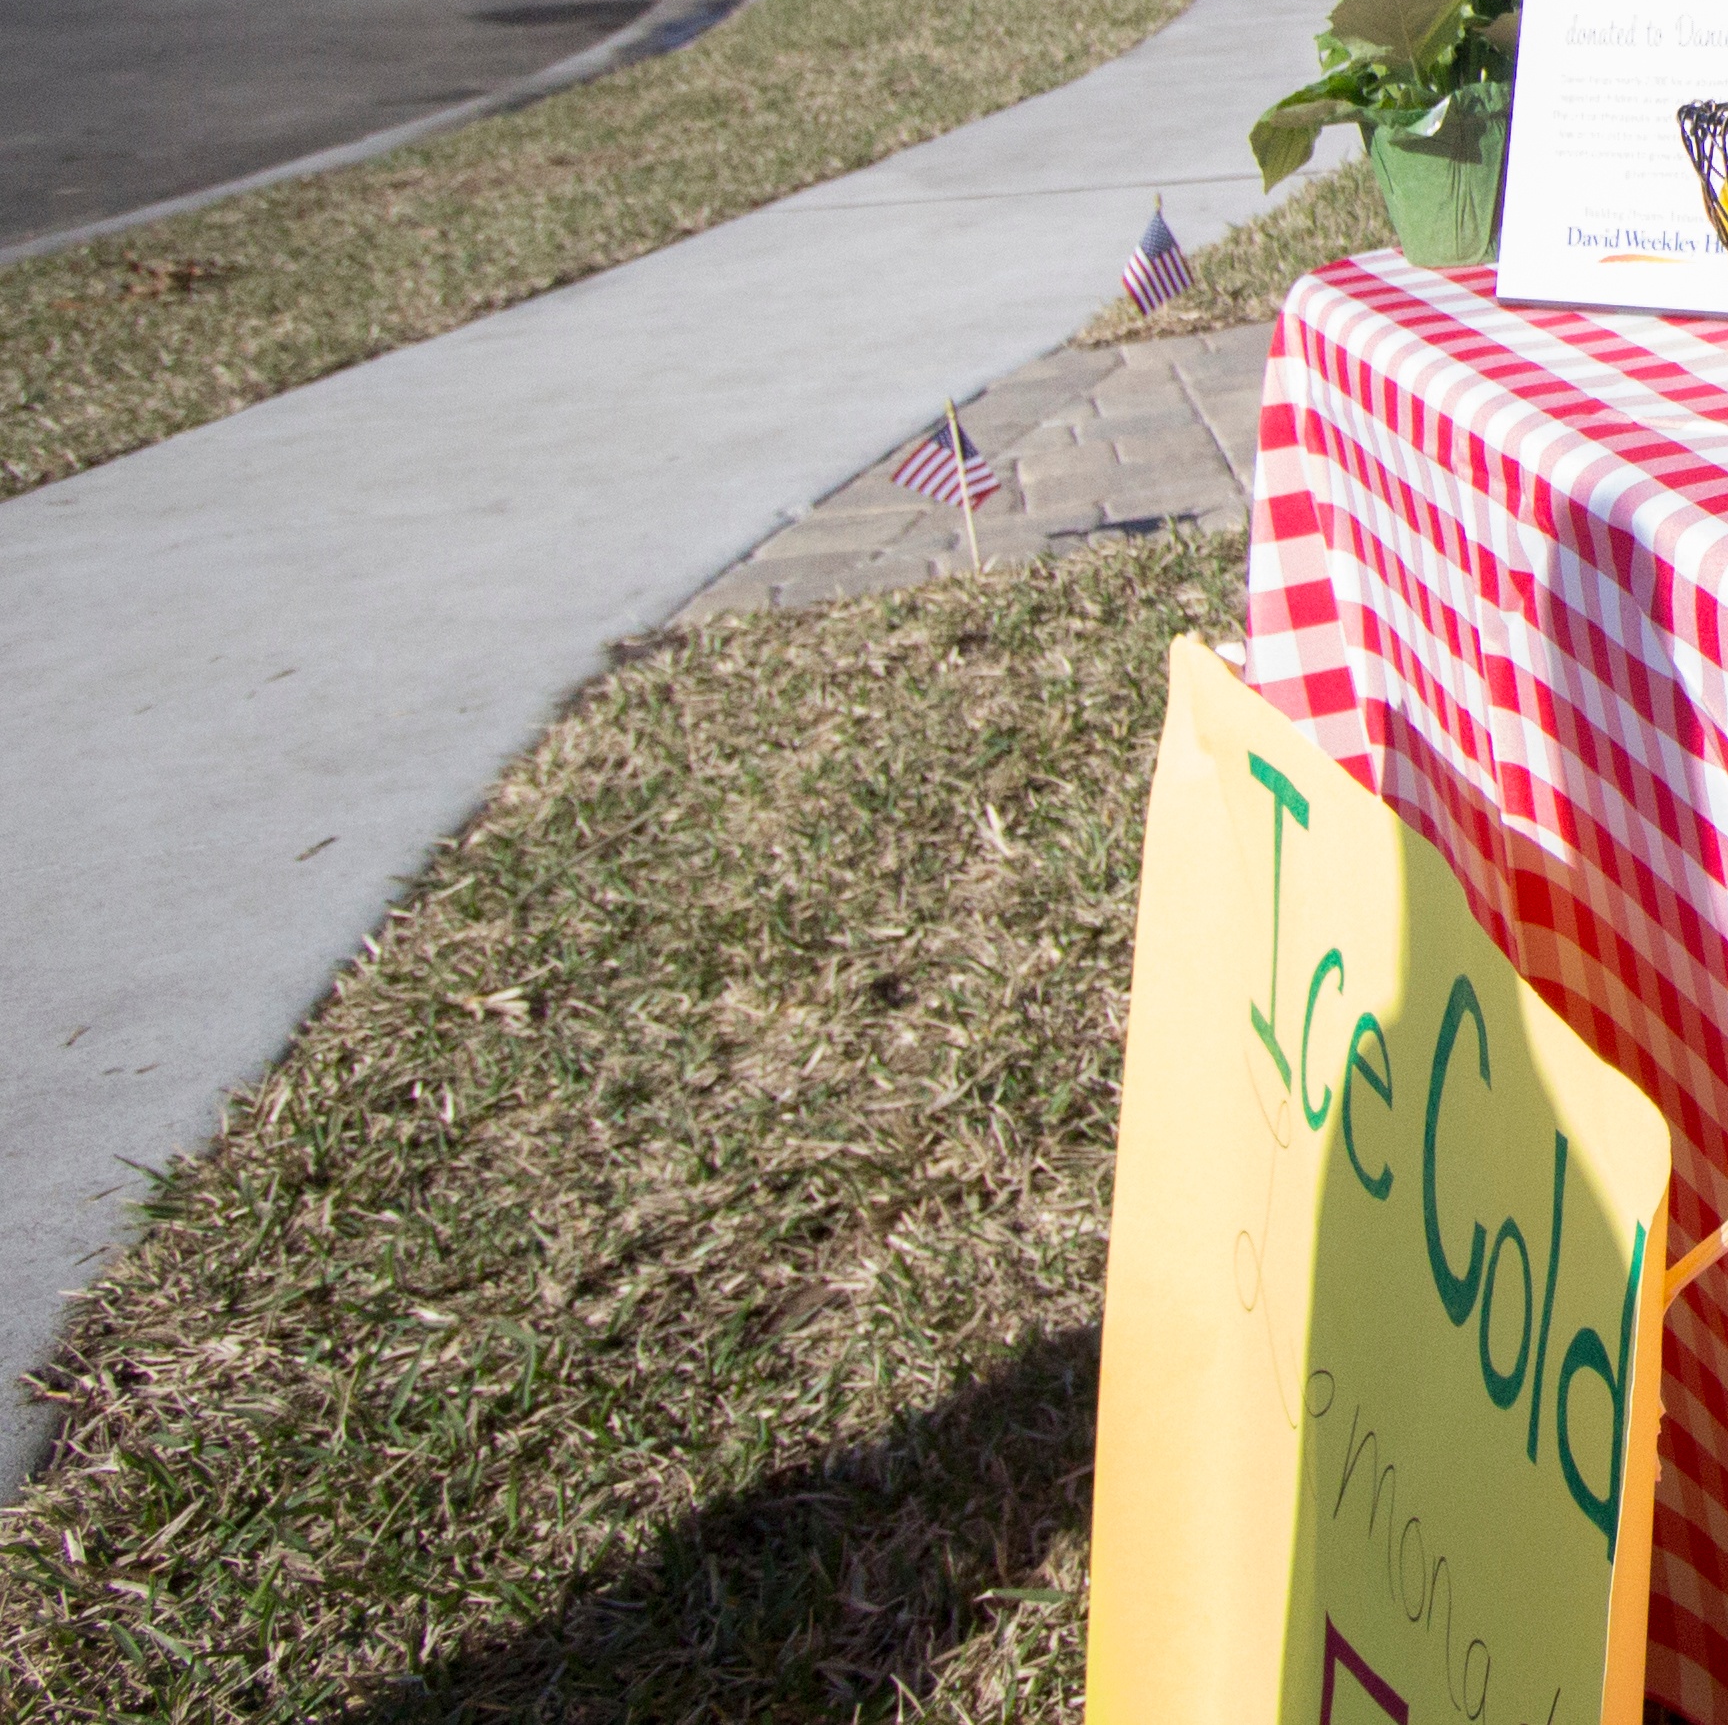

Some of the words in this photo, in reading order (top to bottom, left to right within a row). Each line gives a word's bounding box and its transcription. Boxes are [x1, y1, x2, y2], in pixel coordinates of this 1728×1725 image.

[1565, 13, 1638, 47] donated
[1646, 20, 1663, 47] to
[1567, 227, 1620, 249] David
[1625, 229, 1699, 256] Weekley
[1247, 750, 1394, 1201] Ice
[1423, 974, 1646, 1565] Cold
